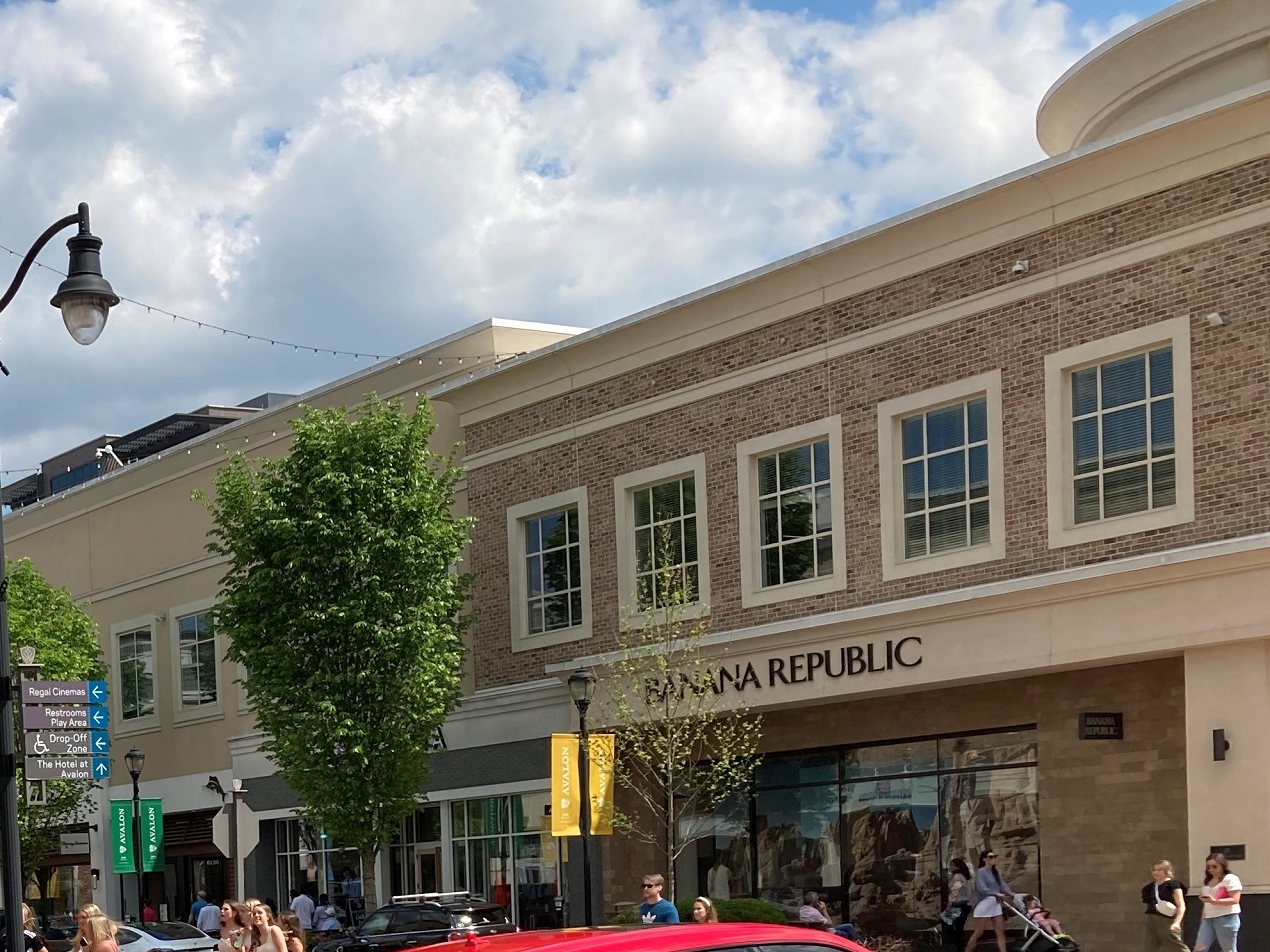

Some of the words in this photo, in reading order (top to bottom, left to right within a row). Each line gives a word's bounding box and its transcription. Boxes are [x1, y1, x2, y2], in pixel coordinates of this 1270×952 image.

[644, 661, 762, 705] BANANA
[768, 636, 923, 687] REPUBLIC
[29, 687, 51, 698] Regal
[52, 687, 86, 696] Cinemas
[45, 708, 87, 717] Restrooms
[51, 718, 68, 728] Play
[68, 718, 87, 727] Area
[49, 733, 88, 744] Drop-Off
[66, 744, 88, 753] Zone
[37, 760, 53, 769] The
[55, 760, 78, 768] Hotel
[79, 760, 89, 768] at
[60, 770, 89, 778] Avalon
[561, 746, 570, 796] AVALON
[118, 808, 126, 845] AVALON
[148, 806, 157, 843] AVALON
